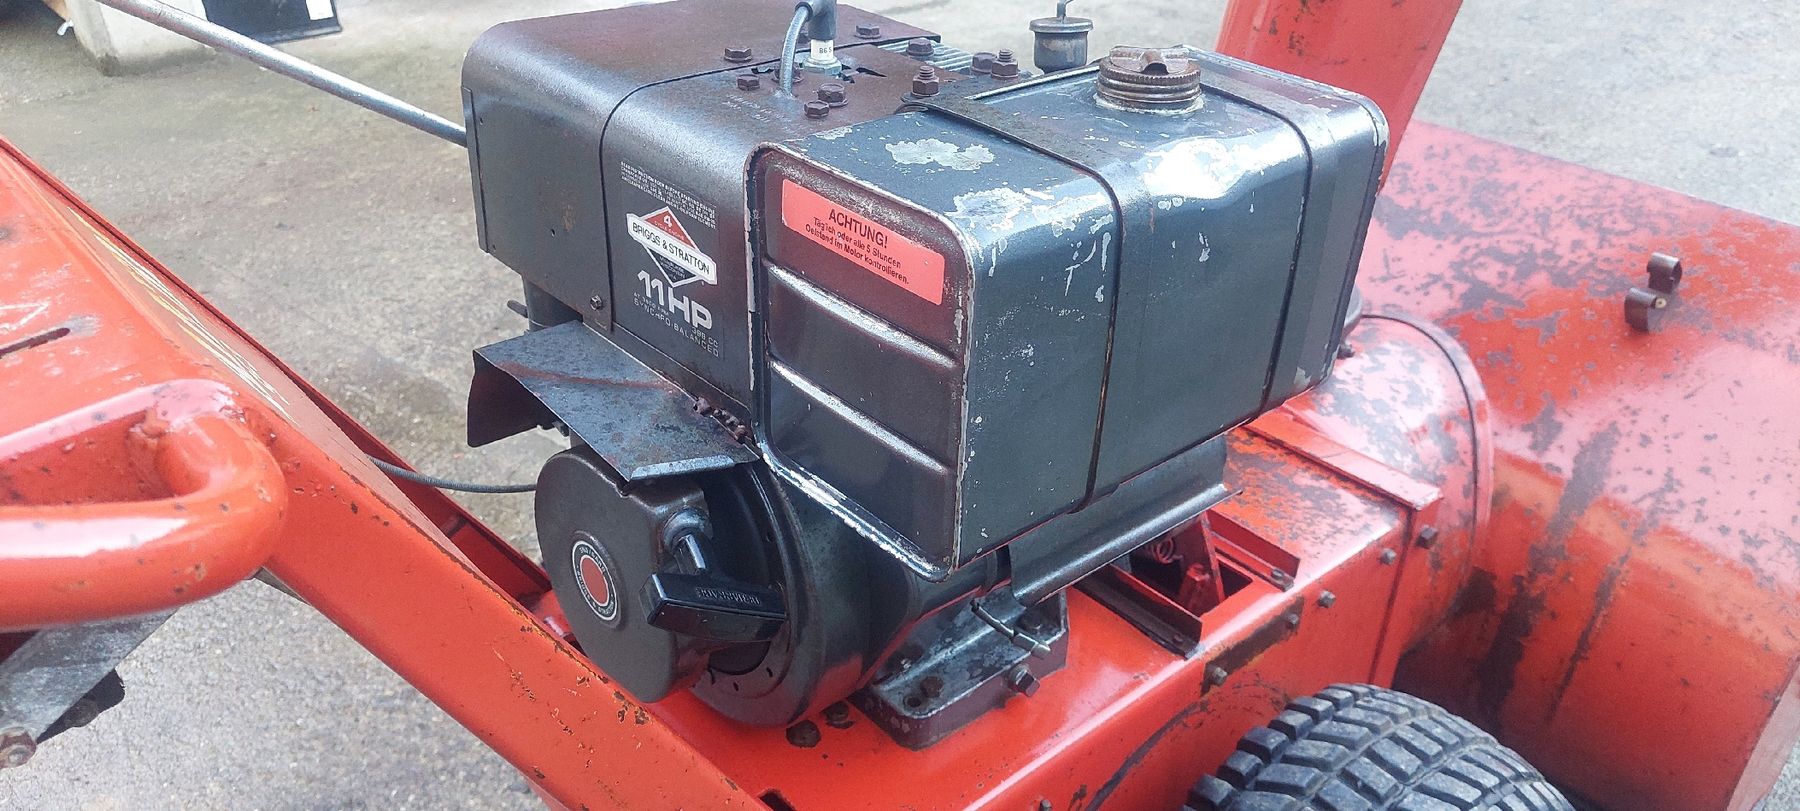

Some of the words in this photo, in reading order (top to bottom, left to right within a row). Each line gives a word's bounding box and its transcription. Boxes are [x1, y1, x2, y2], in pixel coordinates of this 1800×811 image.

[663, 215, 672, 228] 4
[828, 208, 889, 249] ACHTUNG!
[632, 222, 661, 246] BRIGGS
[662, 239, 669, 252] &
[668, 243, 710, 275] STRATTON
[805, 223, 834, 246] Oelstand
[834, 238, 843, 250] im
[843, 242, 864, 261] Motor
[864, 253, 910, 285] kontrollieren.
[836, 230, 852, 244] oder
[853, 239, 866, 251] alle
[866, 244, 871, 254] 5
[872, 247, 901, 269] Stunden
